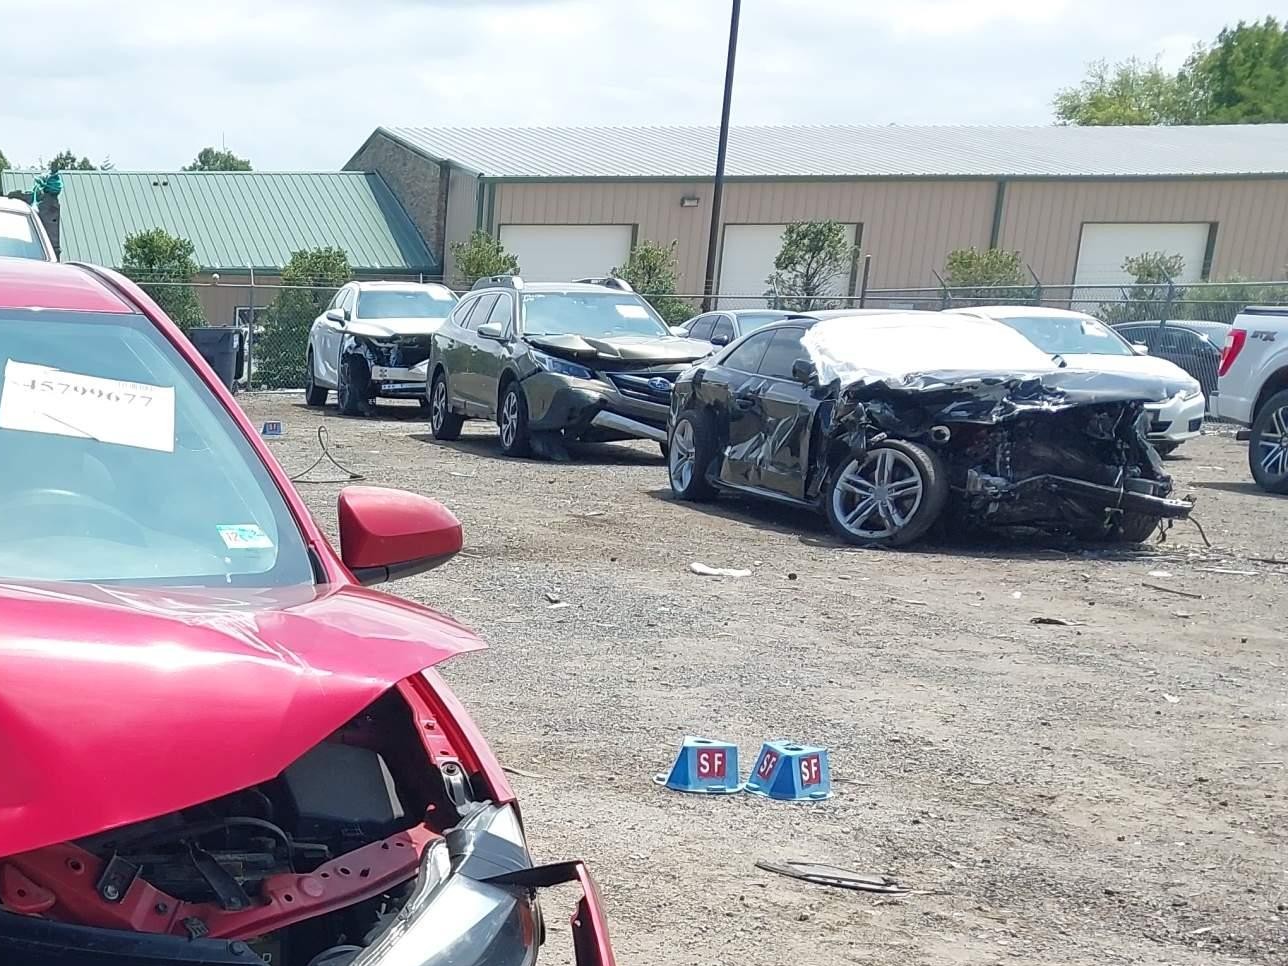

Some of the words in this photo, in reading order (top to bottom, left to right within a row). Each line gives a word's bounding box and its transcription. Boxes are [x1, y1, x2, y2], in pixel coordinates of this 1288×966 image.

[699, 752, 724, 774] SF
[759, 756, 777, 774] SF
[800, 757, 819, 781] SF
